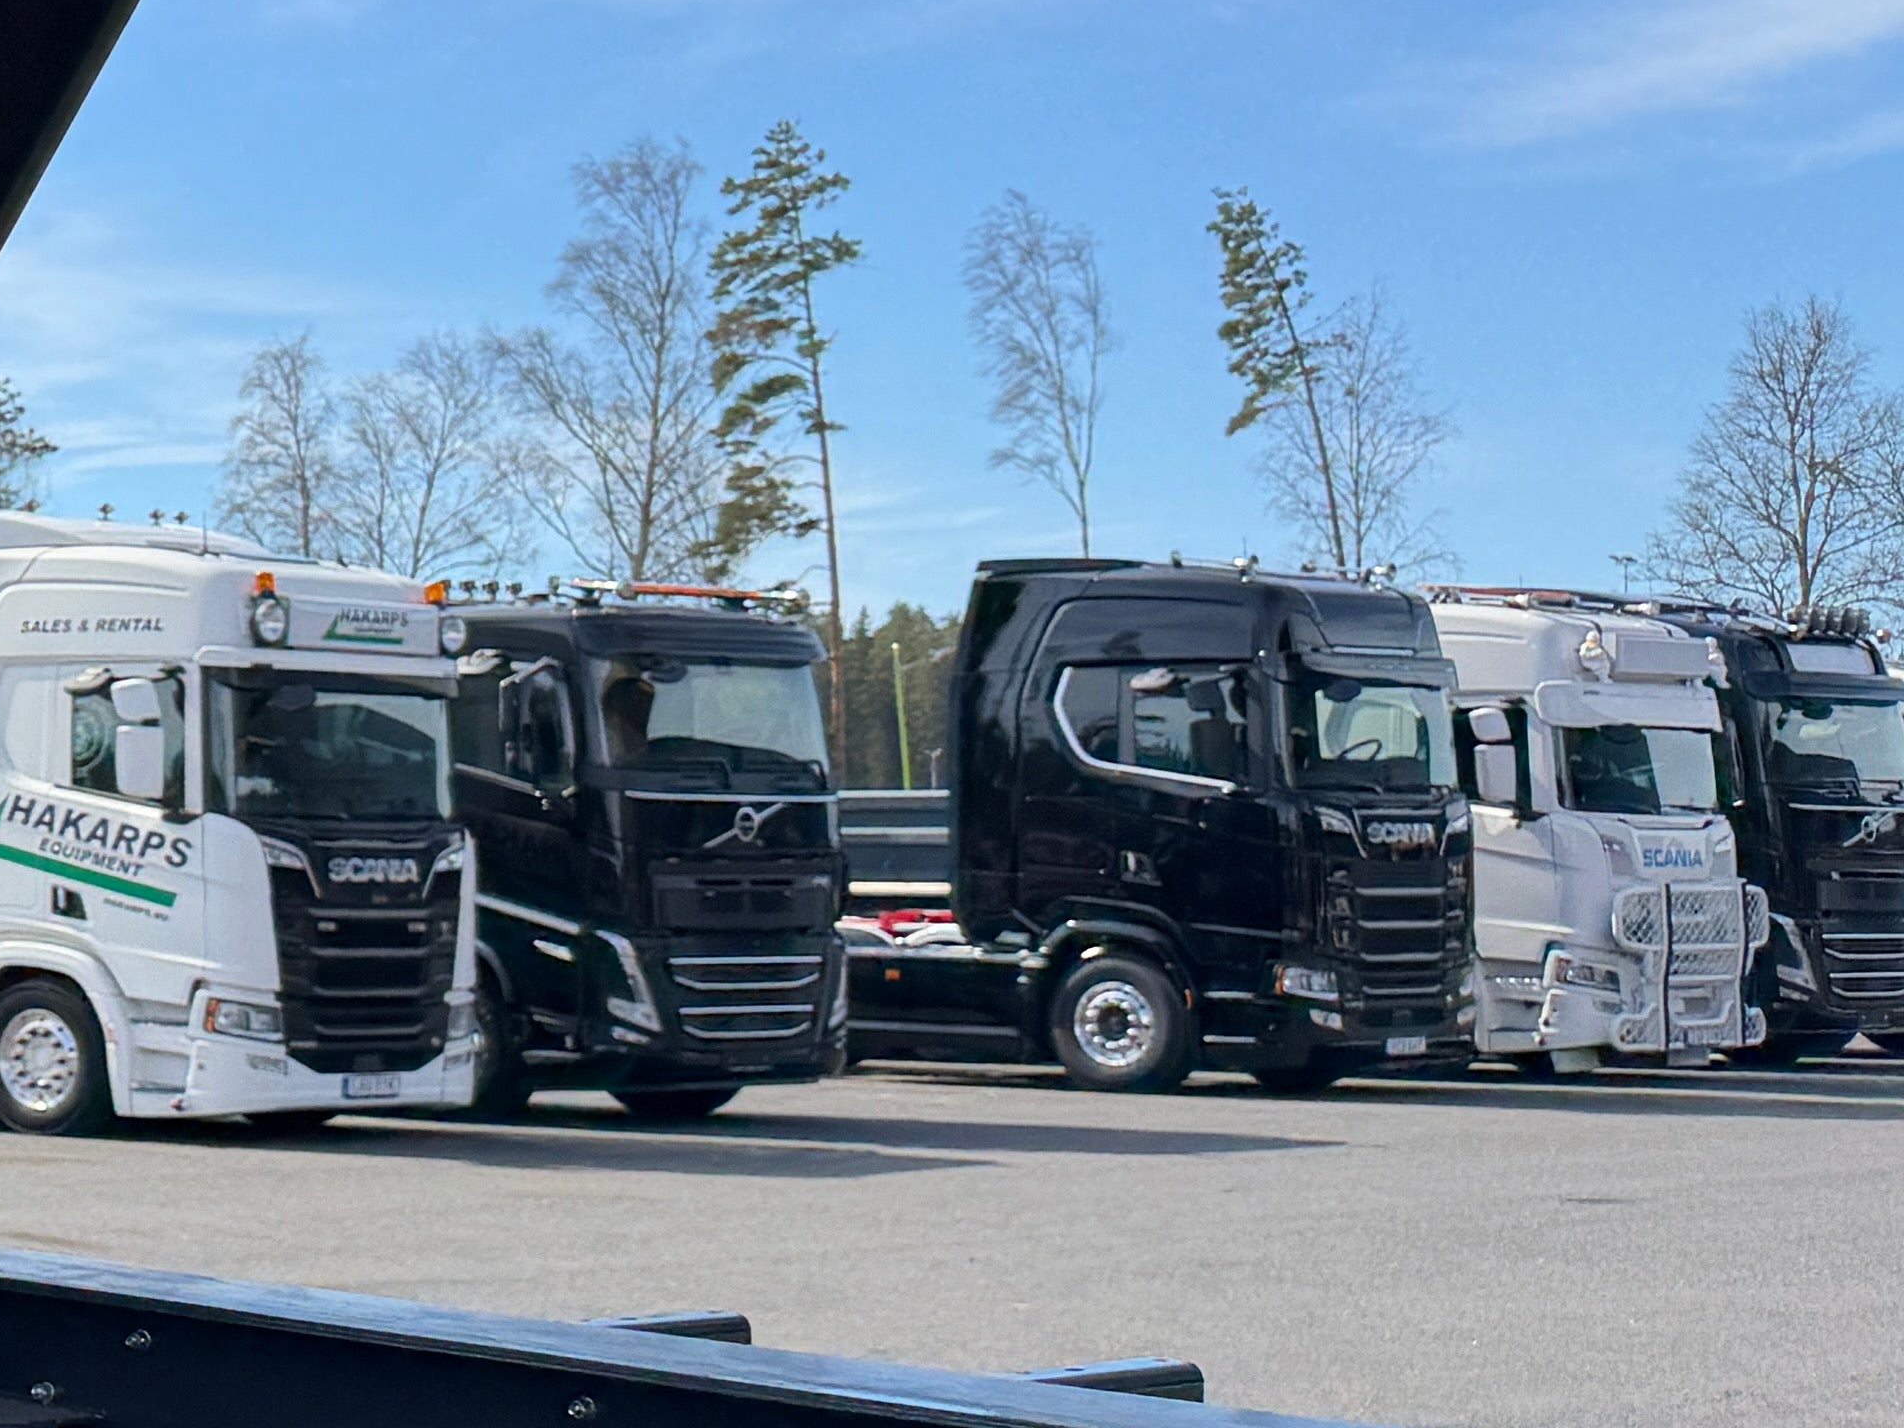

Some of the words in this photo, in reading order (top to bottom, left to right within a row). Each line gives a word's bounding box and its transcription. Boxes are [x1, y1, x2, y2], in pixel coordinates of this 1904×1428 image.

[20, 619, 73, 634] SALES
[78, 619, 89, 632] &
[94, 617, 164, 633] RENTAL
[7, 794, 193, 868] HAKARPS
[39, 837, 144, 877] EQUIPMENT
[328, 856, 419, 884] SCANIA
[1643, 848, 1703, 868] SCANIA
